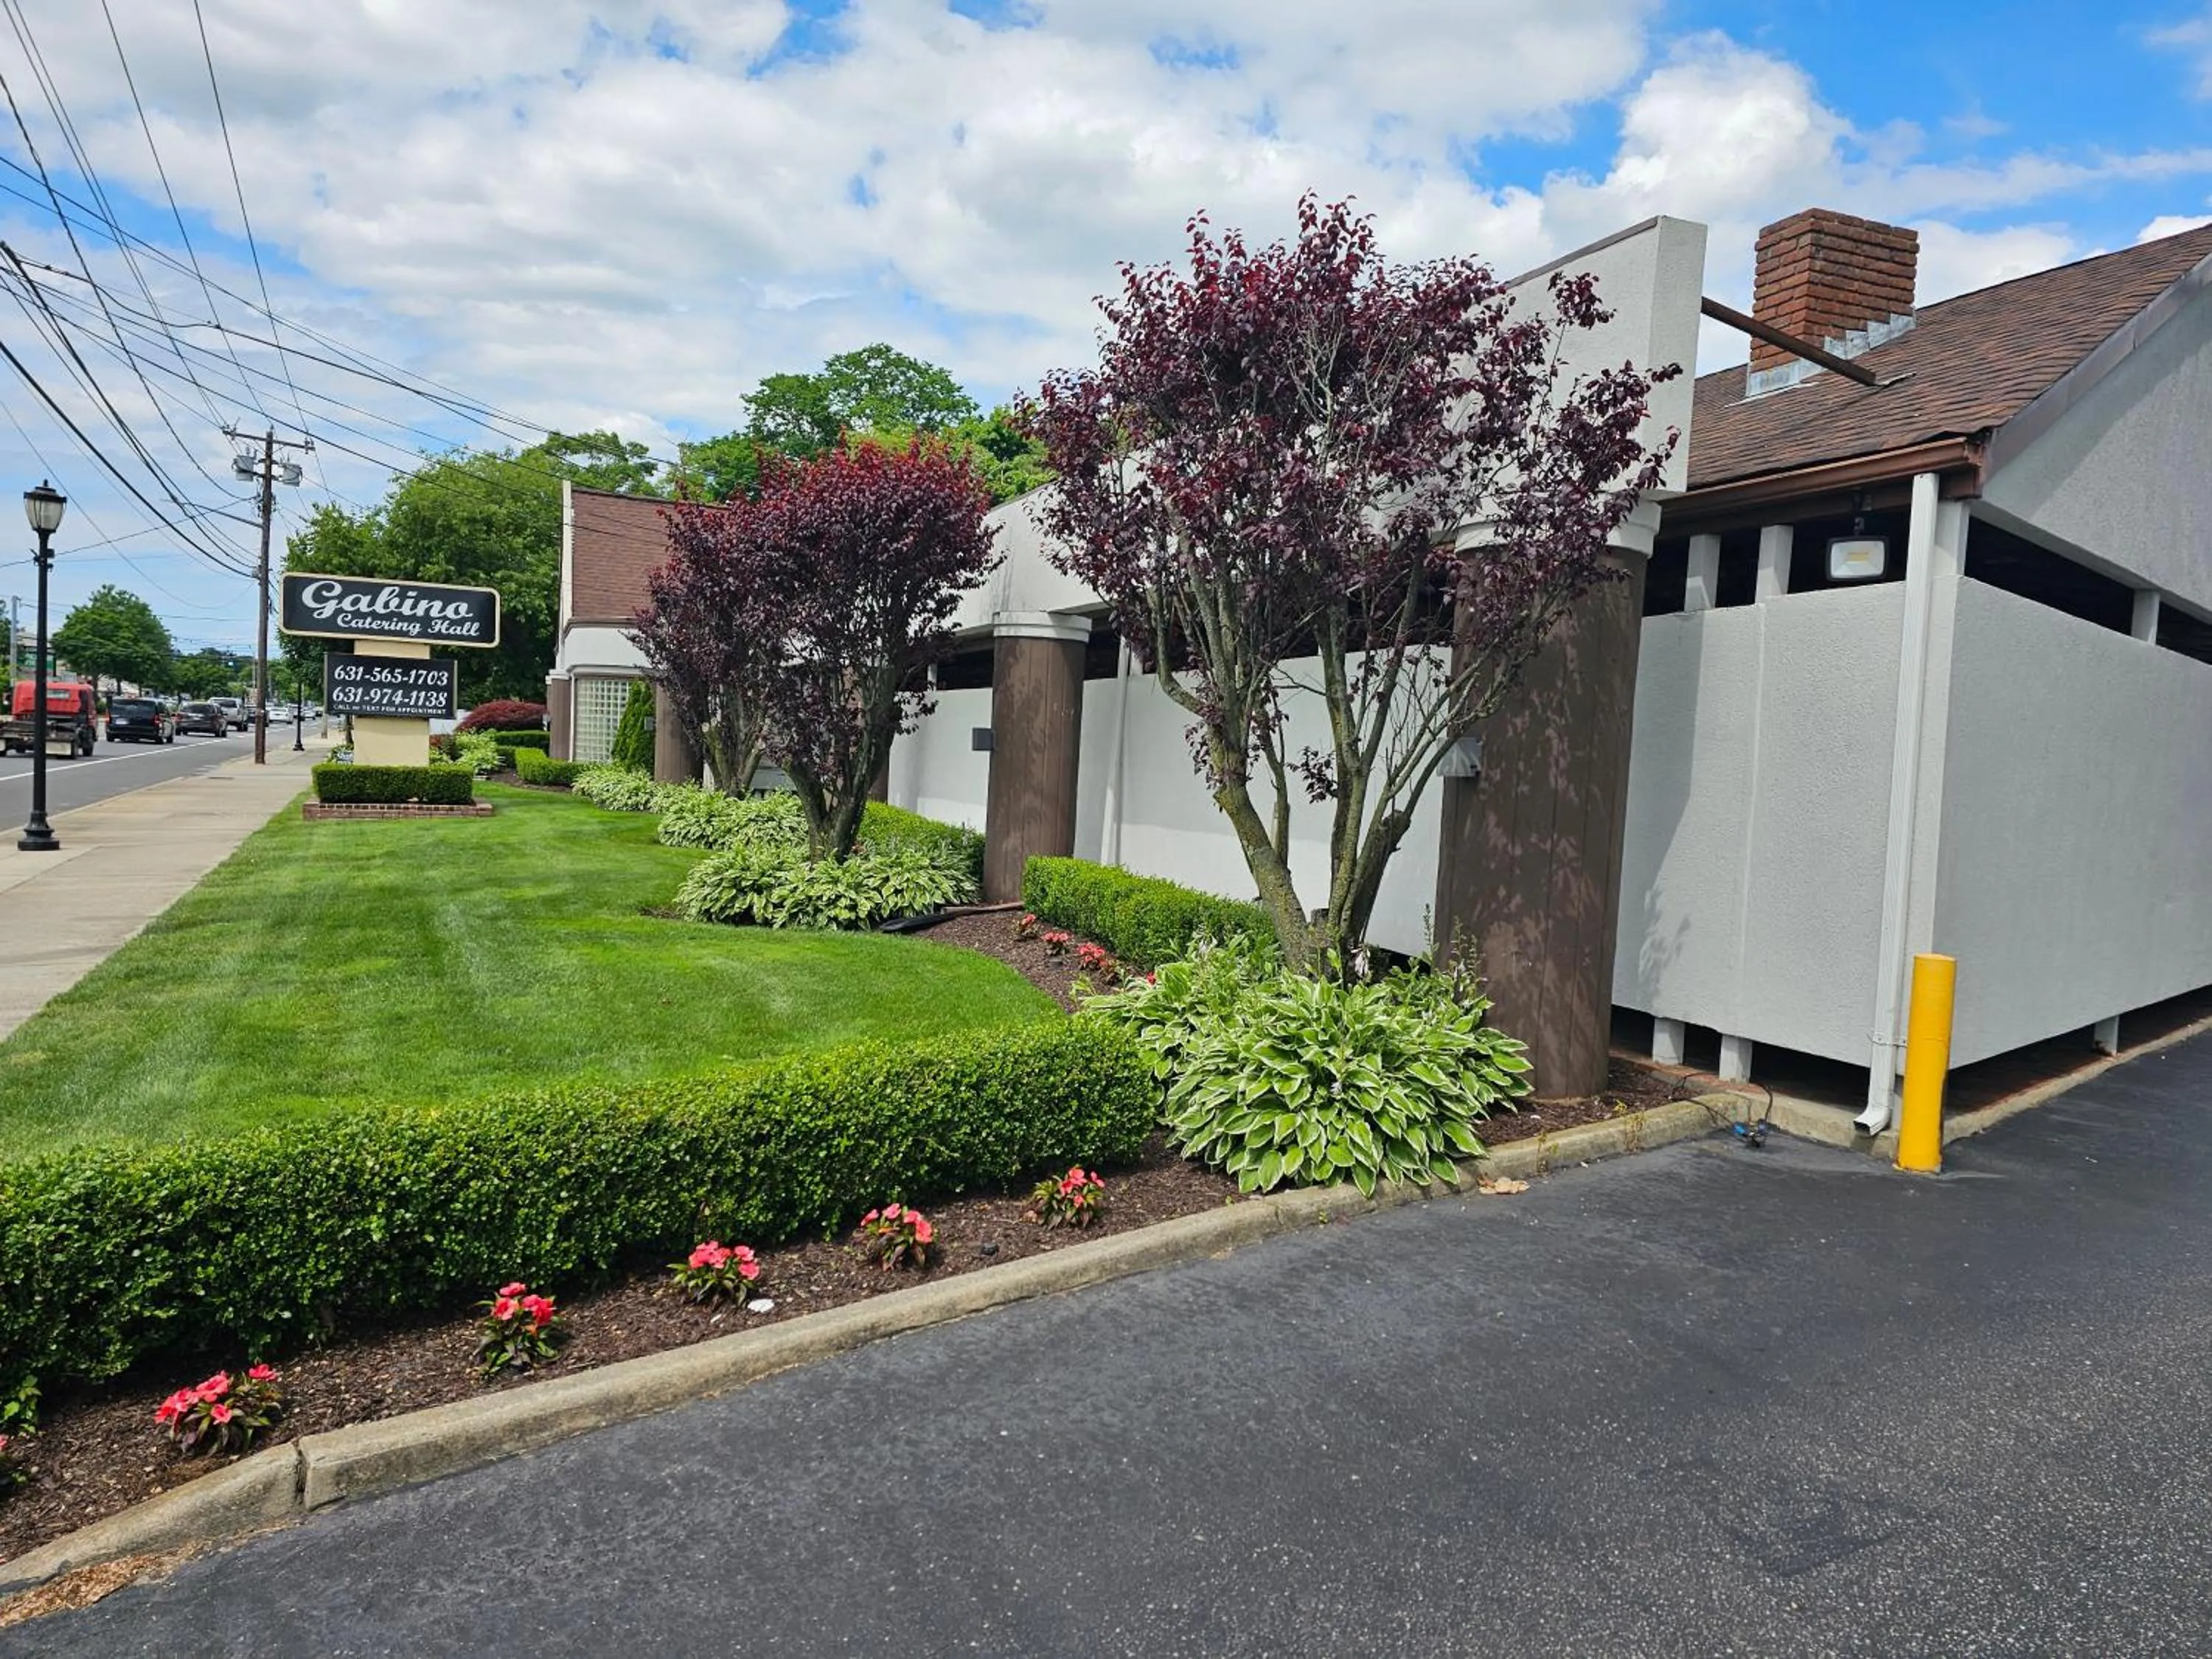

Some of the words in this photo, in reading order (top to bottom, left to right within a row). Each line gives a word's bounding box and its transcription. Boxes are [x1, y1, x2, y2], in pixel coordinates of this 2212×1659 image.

[302, 580, 473, 619] Gabino
[337, 613, 421, 636] Catering
[428, 619, 479, 636] Hall
[334, 665, 448, 686] 631-565-1703
[333, 686, 448, 706] 631-974-1138
